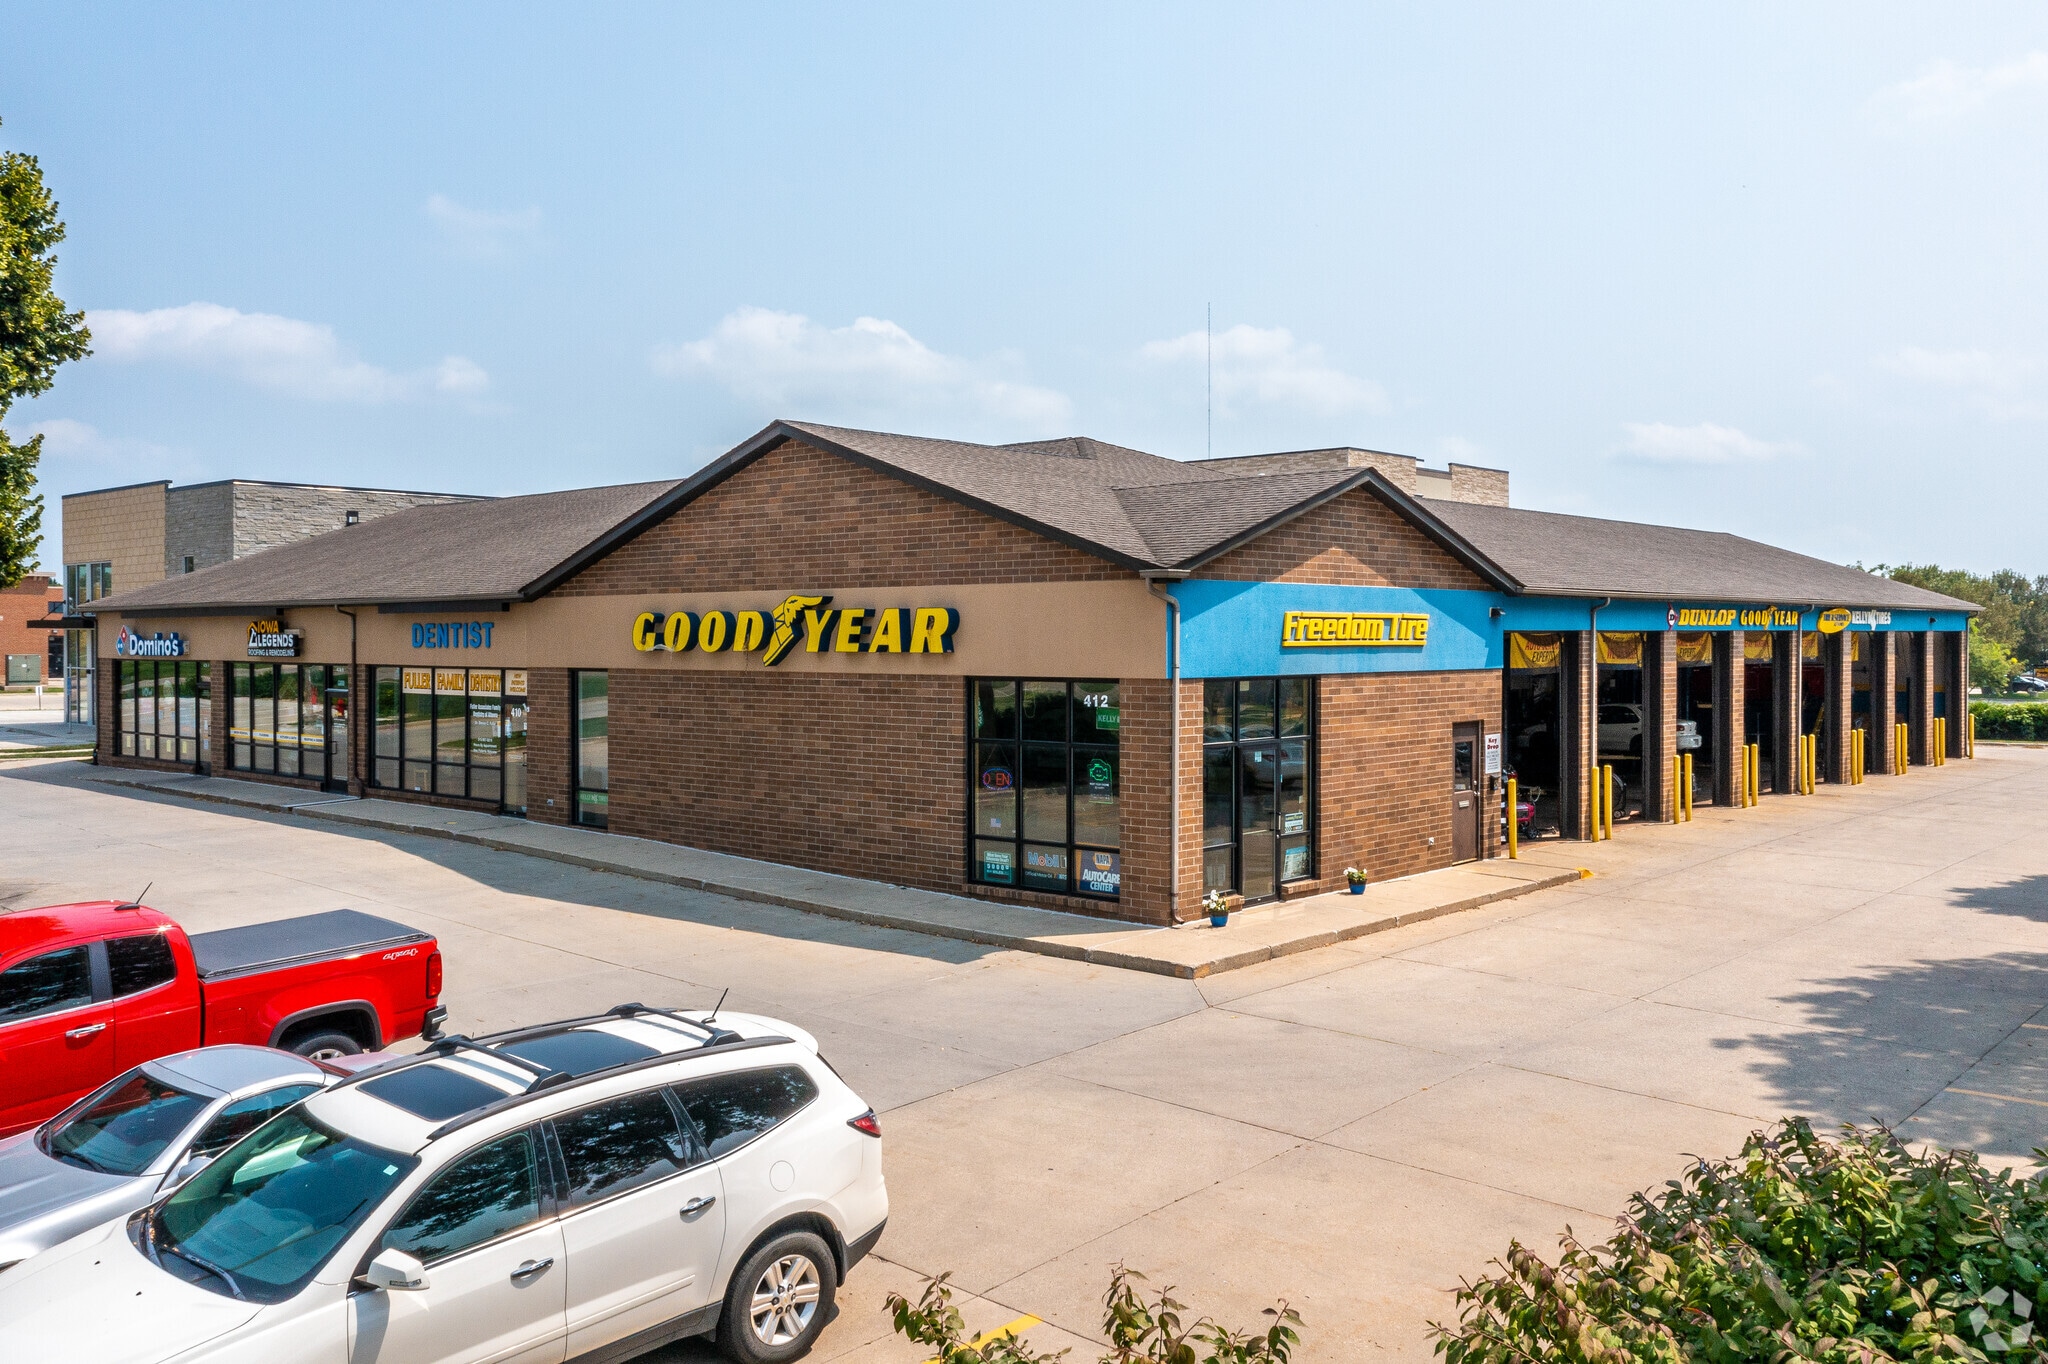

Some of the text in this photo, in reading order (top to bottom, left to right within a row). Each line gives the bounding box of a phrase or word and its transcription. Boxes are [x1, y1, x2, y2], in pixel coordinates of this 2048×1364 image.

[1678, 609, 1737, 626] DUNLOP
[1851, 611, 1891, 624] KELLY TIRES
[257, 620, 279, 633] IOWA
[1283, 611, 1430, 641] Freedom Tire
[257, 634, 294, 647] LEGENDS
[411, 621, 494, 648] DENTIST
[129, 632, 179, 656] Domino's
[404, 672, 501, 692] FULLER FAMILY DENTISTRY
[1083, 694, 1108, 707] 412
[511, 707, 522, 717] 410
[1098, 714, 1117, 723] KELLY
[1027, 851, 1060, 868] Mobil
[1096, 853, 1110, 865] NAPA
[1090, 881, 1113, 893] CENTER
